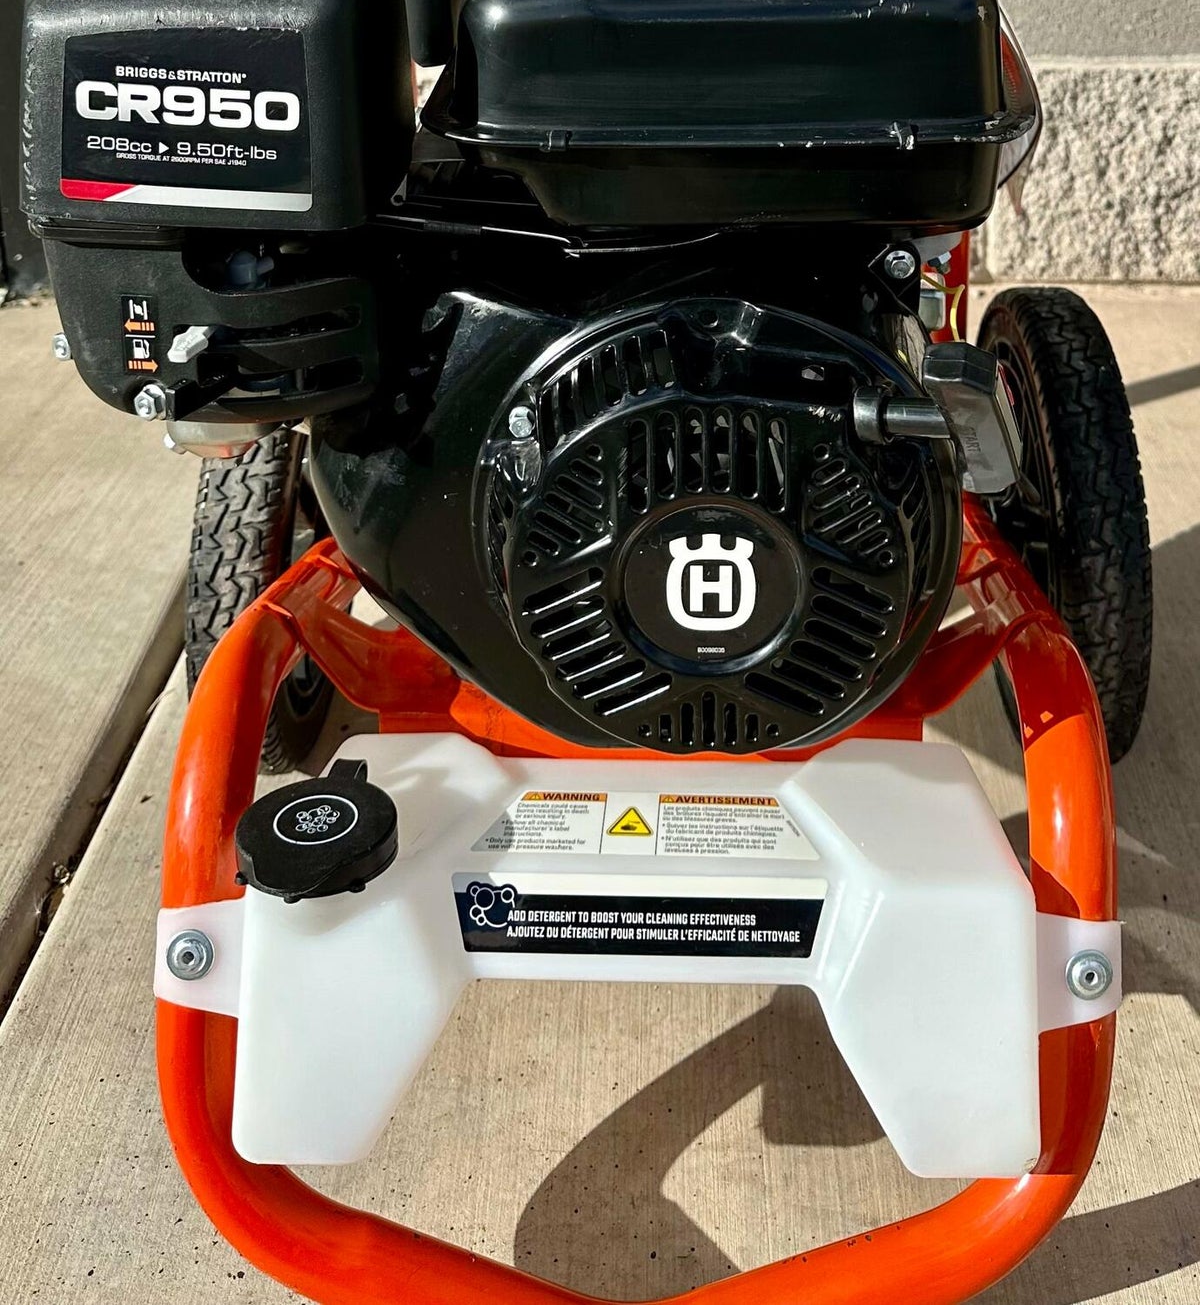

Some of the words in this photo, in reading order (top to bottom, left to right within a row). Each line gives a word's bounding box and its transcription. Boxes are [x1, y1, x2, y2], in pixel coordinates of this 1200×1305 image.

[75, 80, 300, 131] CR950
[87, 136, 152, 153] 208cc
[177, 142, 277, 160] 9.50ft-lbs
[543, 793, 600, 801] WARNING
[675, 796, 772, 805] AVERTISSEMENT
[507, 910, 526, 922] ADD
[527, 910, 577, 922] DETERGENT
[578, 911, 589, 923] TO
[590, 911, 619, 923] BOOST
[620, 912, 644, 924] YOUR
[645, 913, 688, 925] CLEANING
[689, 914, 756, 926] EFFECTIVENESS
[506, 925, 545, 938] AJOUTEZ
[546, 926, 559, 938] DU
[560, 924, 609, 939] DÉTERGENT
[611, 927, 635, 940] POUR
[636, 928, 679, 940] STIMULER
[680, 927, 736, 942] L'EFFICACITÉ
[738, 930, 749, 942] DE
[751, 930, 800, 942] NETTOYAGE
